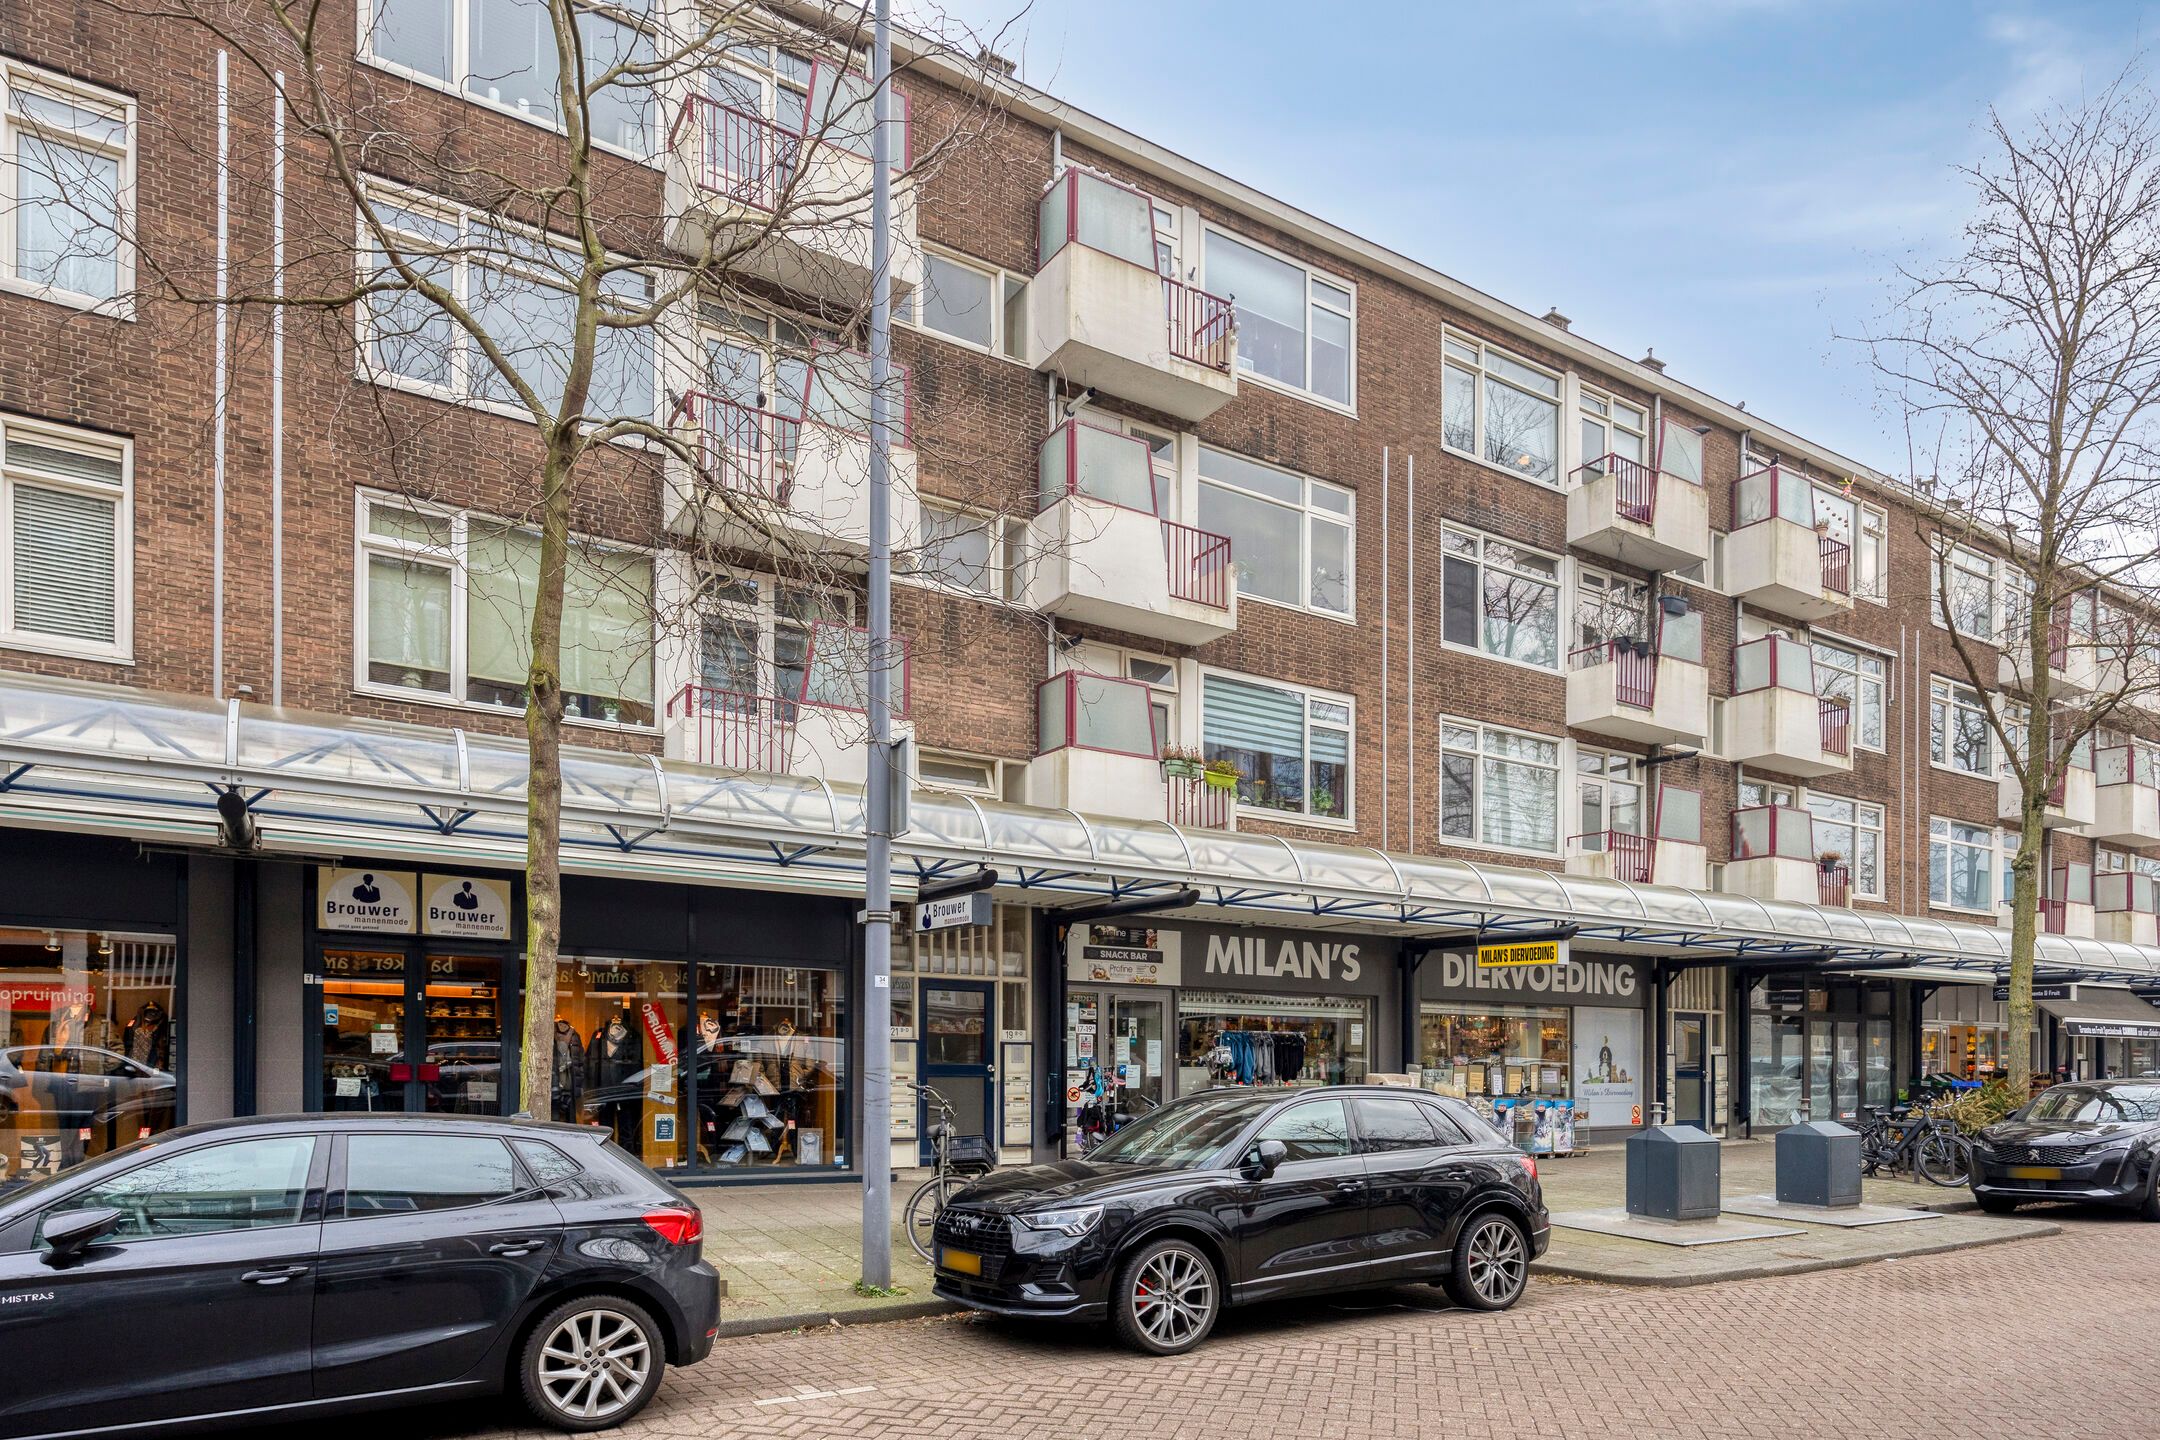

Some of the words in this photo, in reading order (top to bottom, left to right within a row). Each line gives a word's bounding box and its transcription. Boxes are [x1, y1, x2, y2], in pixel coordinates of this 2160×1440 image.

[326, 900, 400, 917] Brouwer
[430, 906, 496, 924] Brouwer
[933, 901, 966, 918] Brouwer
[354, 916, 409, 926] mannenmode
[455, 922, 504, 932] mannenmode
[943, 915, 970, 925] mannenmode
[1100, 950, 1129, 960] SNACK
[1130, 952, 1148, 961] BAR
[1205, 934, 1361, 982] MILAN'S
[1481, 949, 1509, 964] MILAN'S
[1510, 945, 1555, 963] DIERVOEDING
[1109, 963, 1133, 973] Profine
[1442, 952, 1636, 997] DIERVOEDING
[0, 987, 95, 1005] opruiming
[641, 1003, 679, 1067] OPRUIMING
[890, 1027, 899, 1037] 21
[1006, 1030, 1014, 1039] 19
[1, 1291, 55, 1305] MISTRAS
